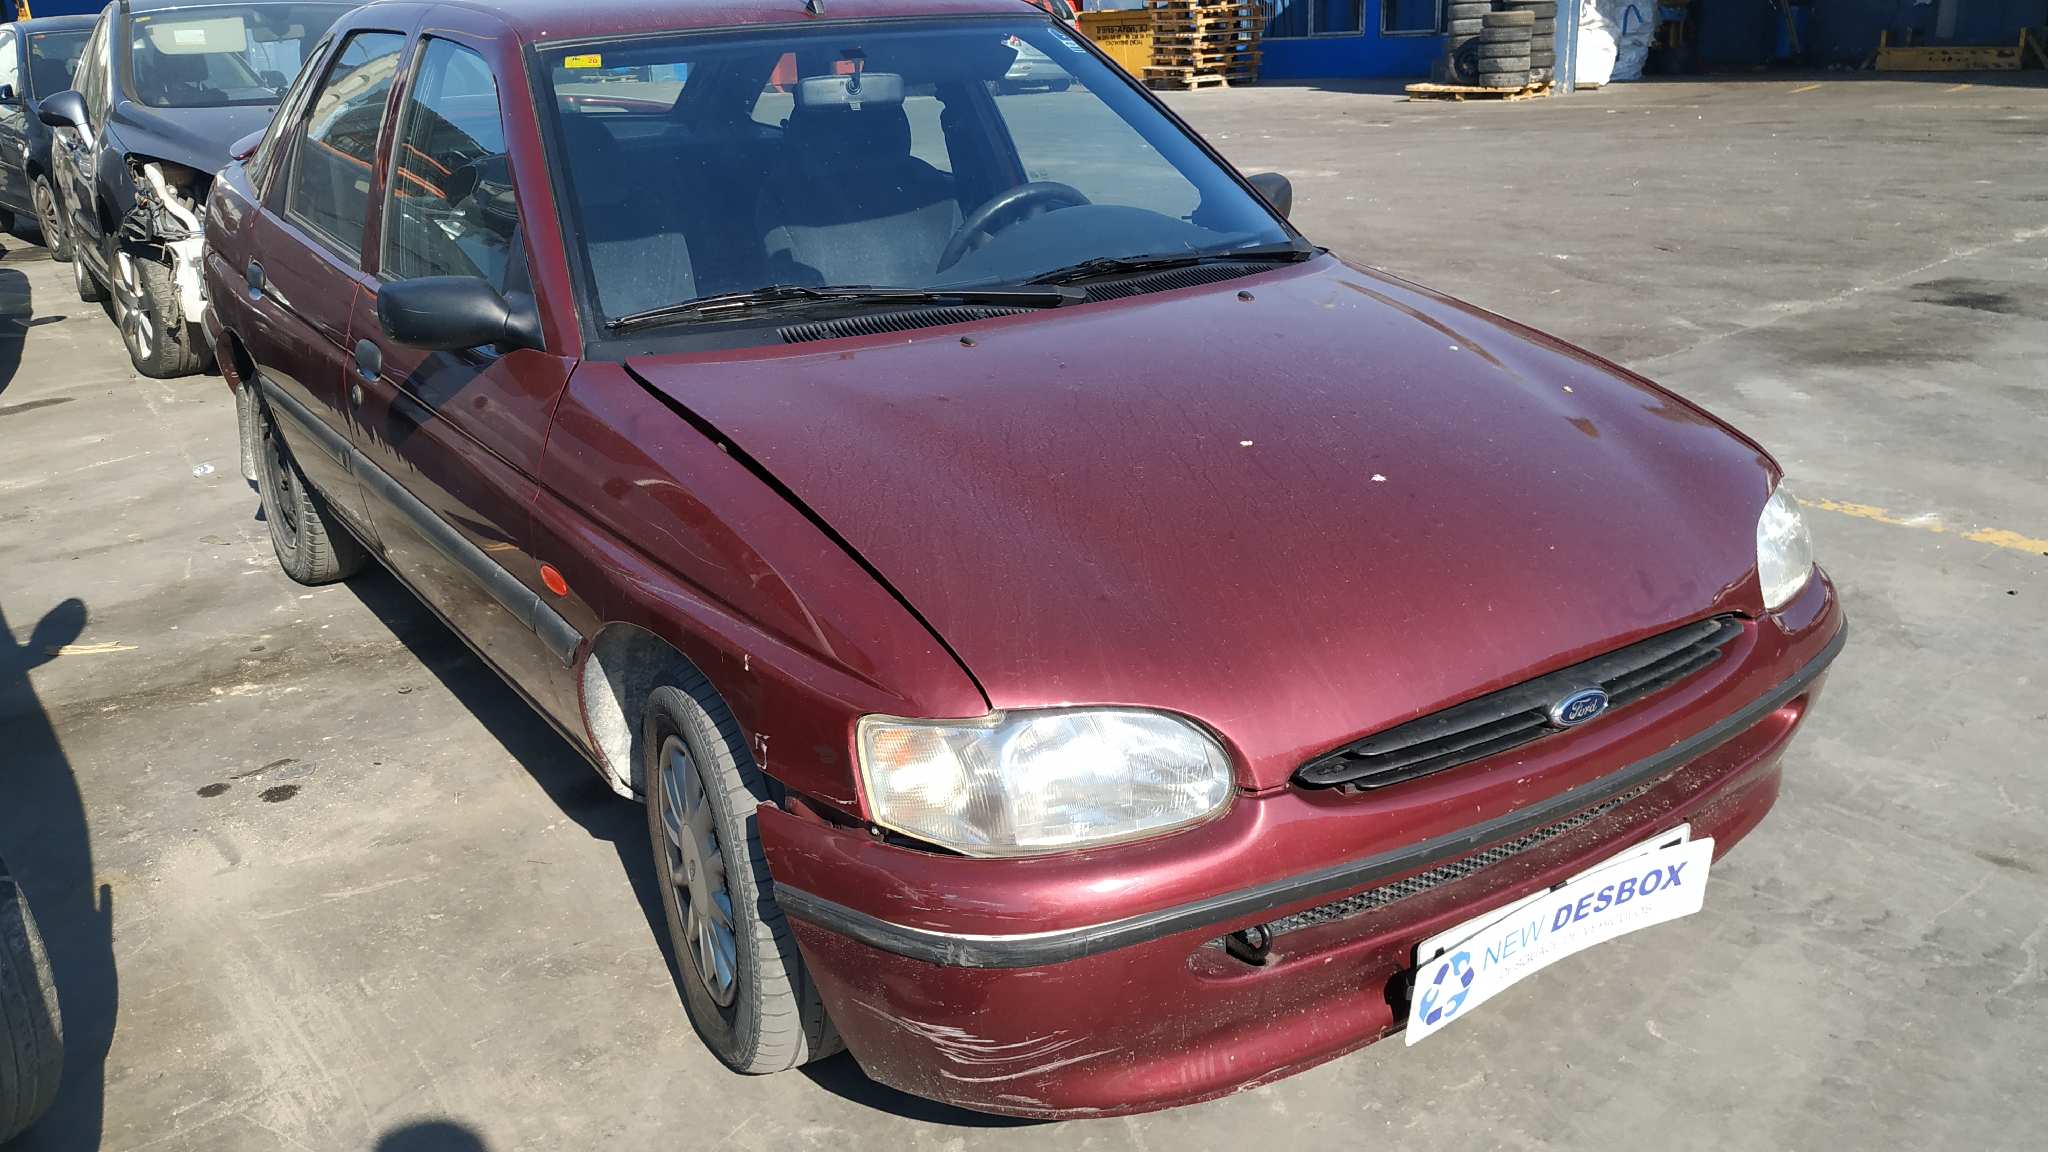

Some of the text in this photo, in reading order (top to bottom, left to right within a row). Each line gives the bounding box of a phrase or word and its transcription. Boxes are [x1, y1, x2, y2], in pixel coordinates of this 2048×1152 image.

[1568, 697, 1598, 720] Ford
[1483, 914, 1546, 971] NEW
[1551, 861, 1688, 933] DESBOX
